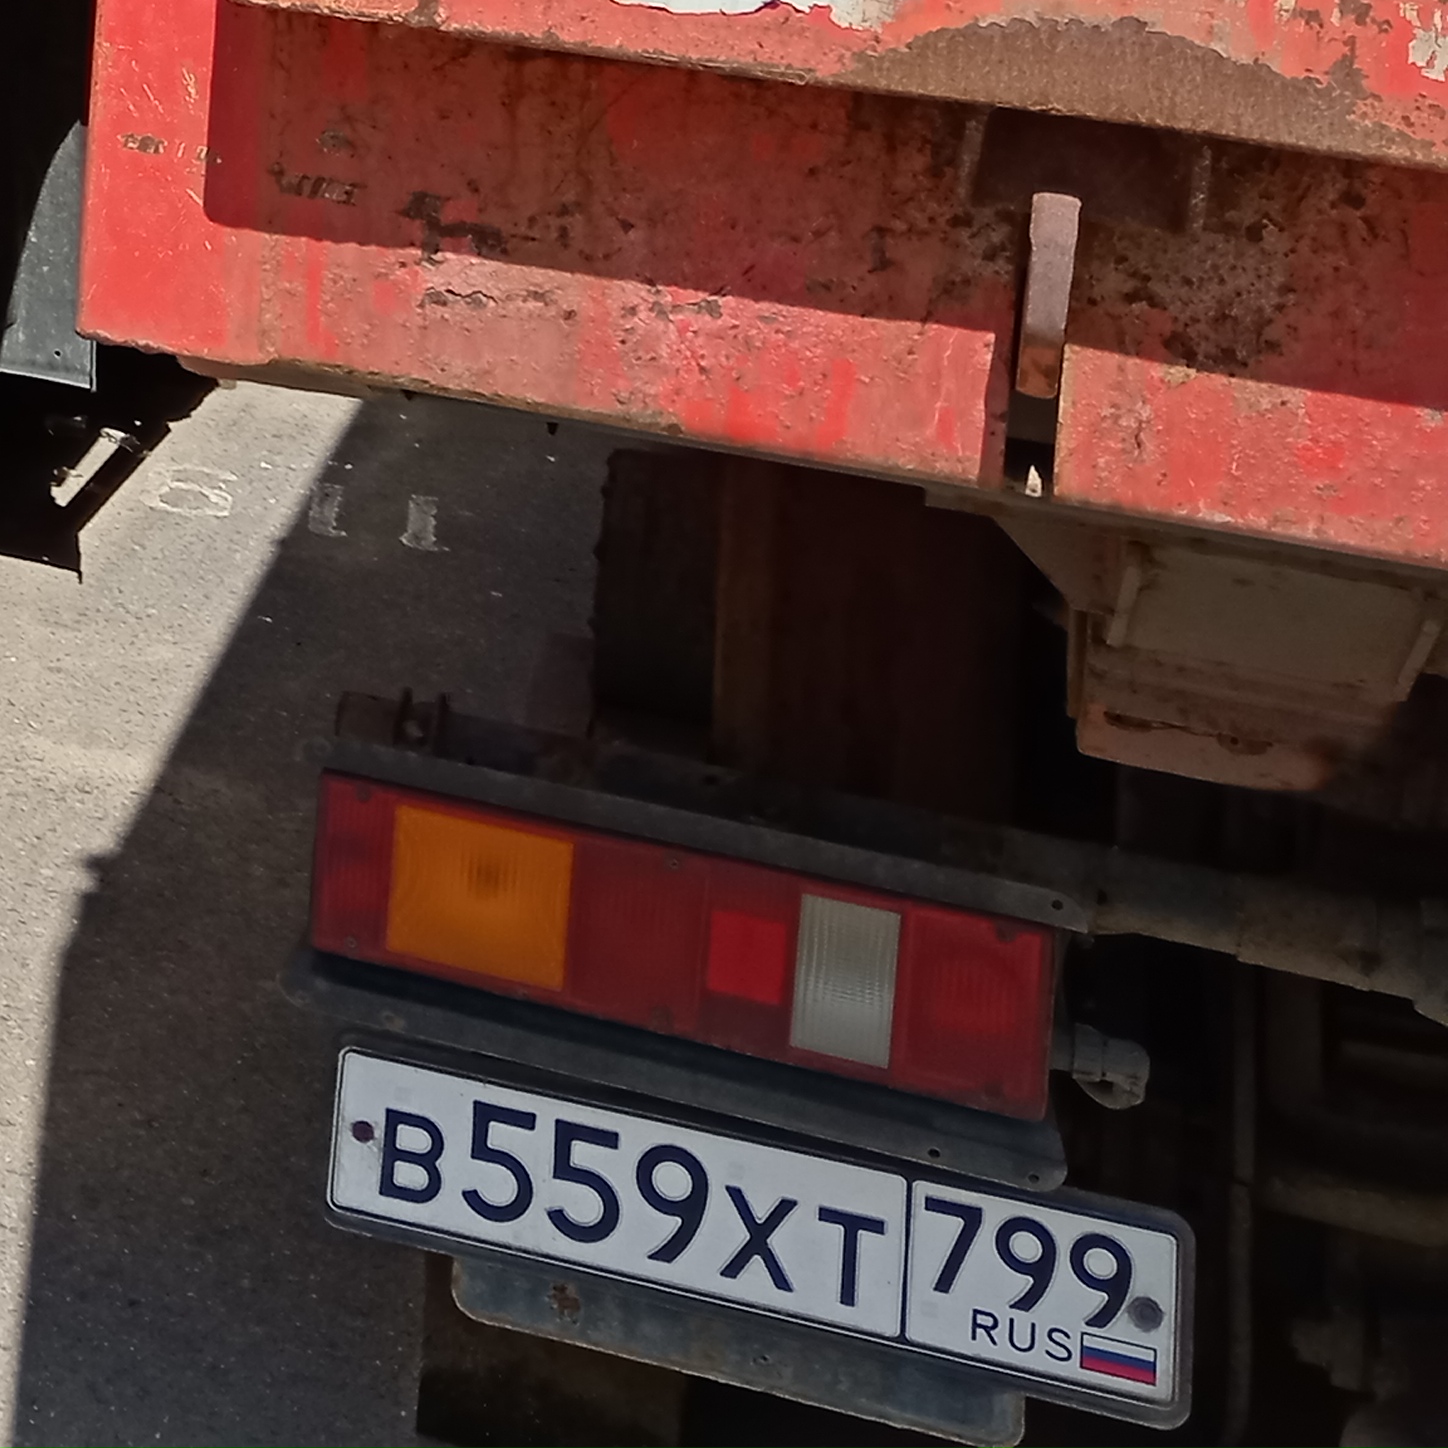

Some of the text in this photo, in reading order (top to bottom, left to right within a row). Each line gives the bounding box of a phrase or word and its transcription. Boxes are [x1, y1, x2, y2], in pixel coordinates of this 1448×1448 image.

[378, 1100, 1133, 1328] В559ХТ 799
[969, 1309, 1074, 1363] RUS
